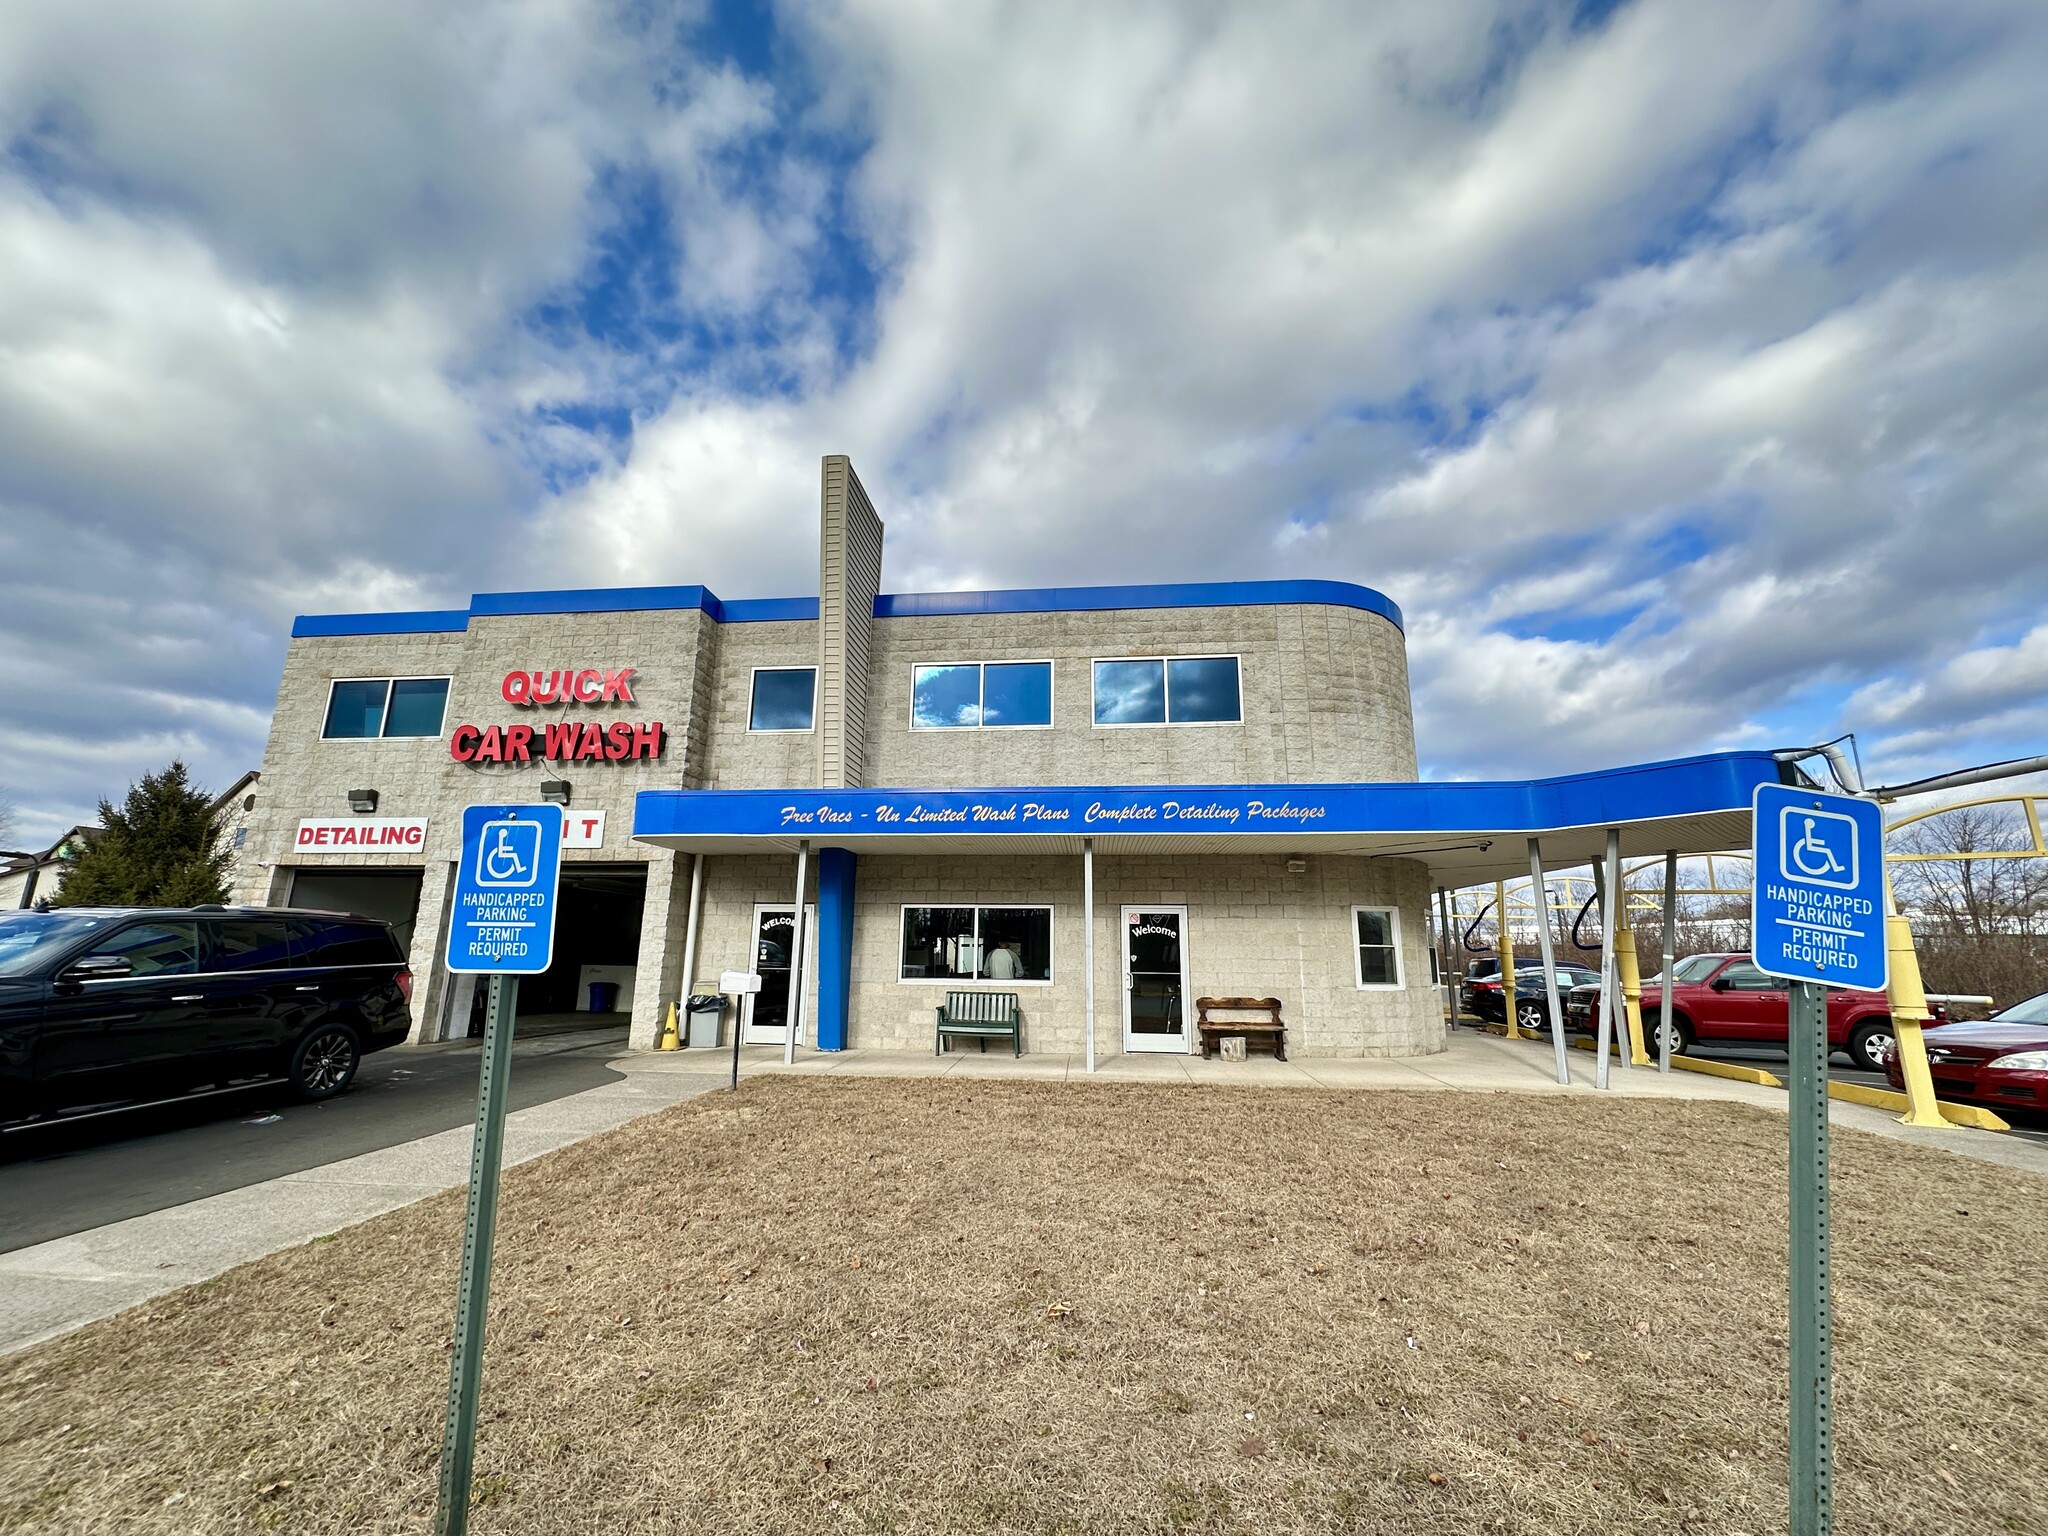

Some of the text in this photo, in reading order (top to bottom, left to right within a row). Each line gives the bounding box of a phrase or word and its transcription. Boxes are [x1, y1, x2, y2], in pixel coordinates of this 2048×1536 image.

[501, 668, 637, 706] QUICK
[450, 721, 663, 762] CAR WASH
[781, 806, 814, 826] Free
[817, 806, 852, 823] Vacs
[876, 805, 900, 823] Un
[904, 805, 968, 823] Limited
[971, 803, 1016, 821] Wash
[1022, 803, 1070, 821] Plans
[1084, 802, 1157, 824] Complete
[1162, 801, 1240, 824] Detailing
[1246, 801, 1326, 824] Packages
[298, 826, 422, 845] DETAILING
[463, 893, 545, 906] HANDICAPPED
[1766, 884, 1872, 915] HANDICAPPED
[477, 907, 527, 921] PARKING
[761, 917, 796, 931] WELCO
[1788, 904, 1852, 928] PARKING
[478, 928, 521, 941] PERMIT
[1131, 924, 1177, 938] Welcome
[1792, 928, 1847, 950] PERMIT
[468, 942, 528, 956] REQUIRED
[1783, 943, 1858, 970] REQUIRED
